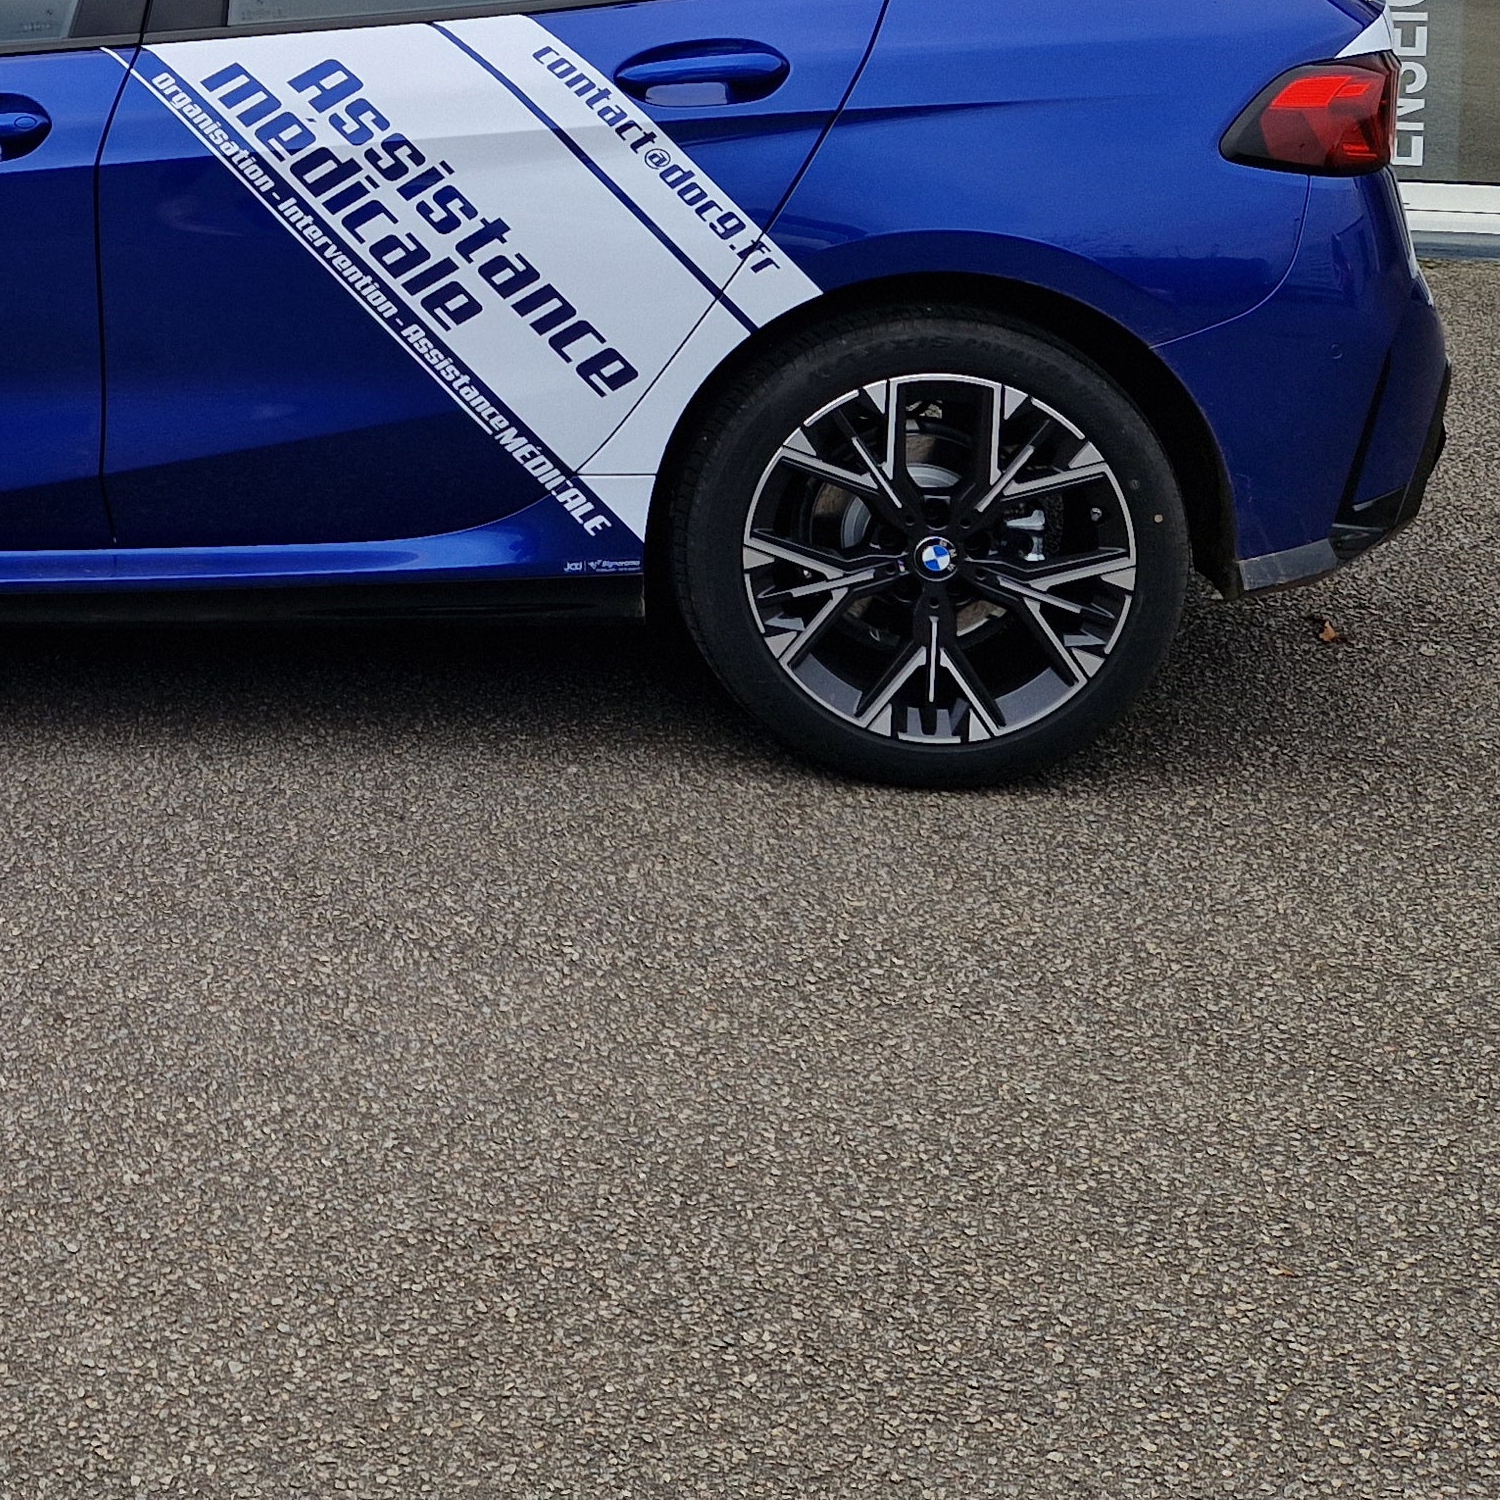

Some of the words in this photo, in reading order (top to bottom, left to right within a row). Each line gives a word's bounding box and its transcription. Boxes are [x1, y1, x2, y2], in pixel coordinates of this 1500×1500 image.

[151, 72, 275, 192] Organisation
[278, 197, 399, 319] Intervention
[401, 323, 510, 431] Assistance
[287, 59, 639, 398] Assistance
